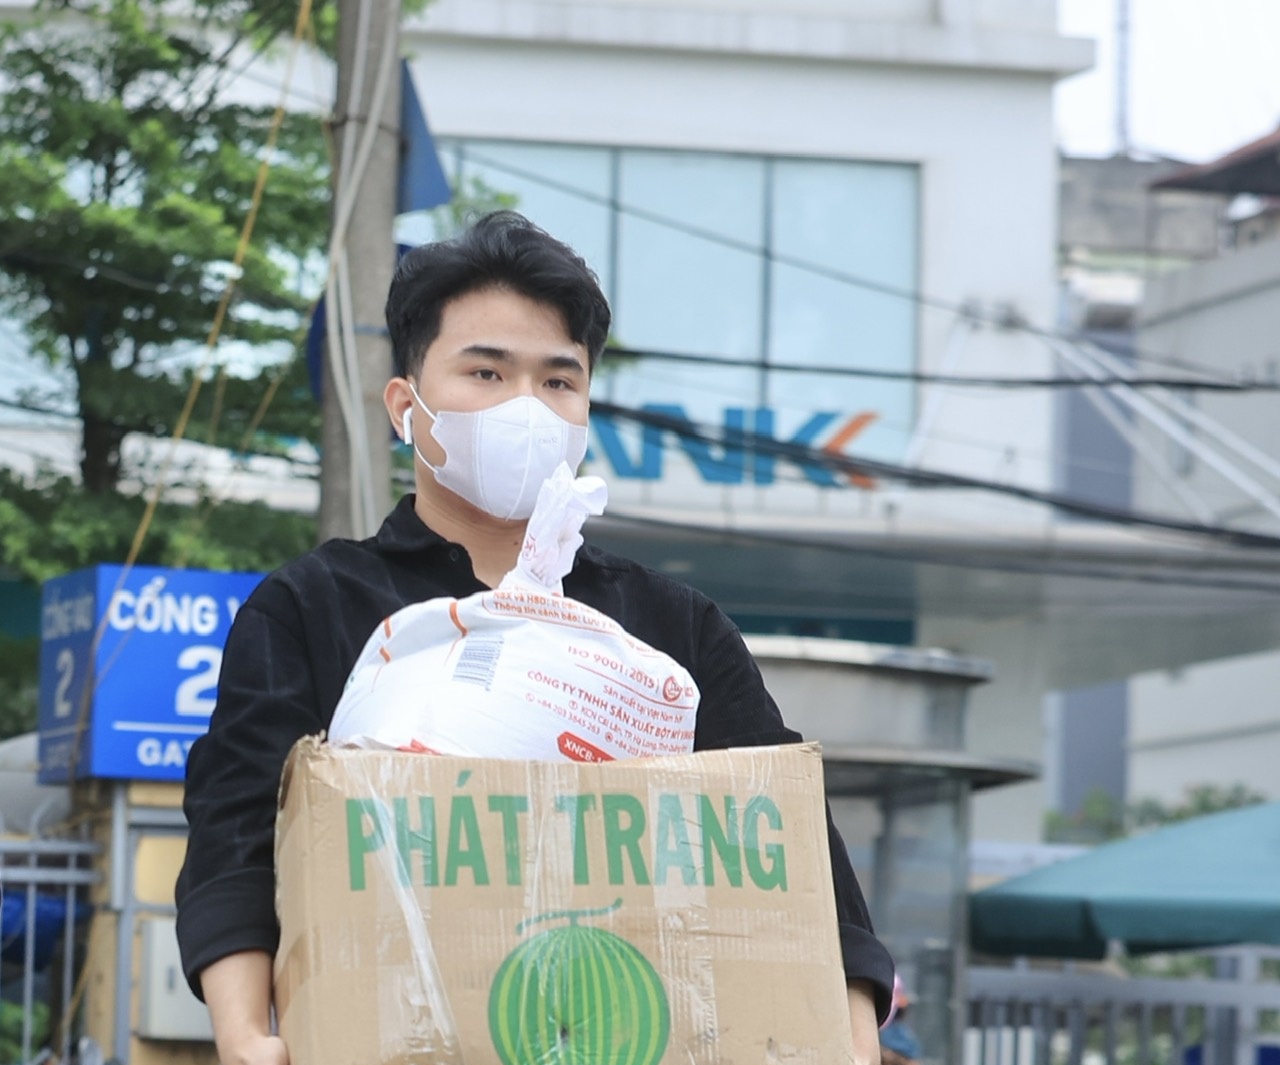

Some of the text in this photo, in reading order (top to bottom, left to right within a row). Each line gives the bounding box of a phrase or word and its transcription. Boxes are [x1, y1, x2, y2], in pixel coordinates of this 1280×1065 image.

[55, 648, 74, 718] 2
[175, 645, 224, 717] 2
[568, 645, 590, 658] ISO
[527, 670, 560, 689] CÔNG
[562, 682, 576, 695] TY
[577, 688, 608, 711] TNHH
[609, 704, 631, 724] SẢN
[631, 717, 655, 735] XUẤT
[346, 770, 789, 892] PHÁT TRANG
